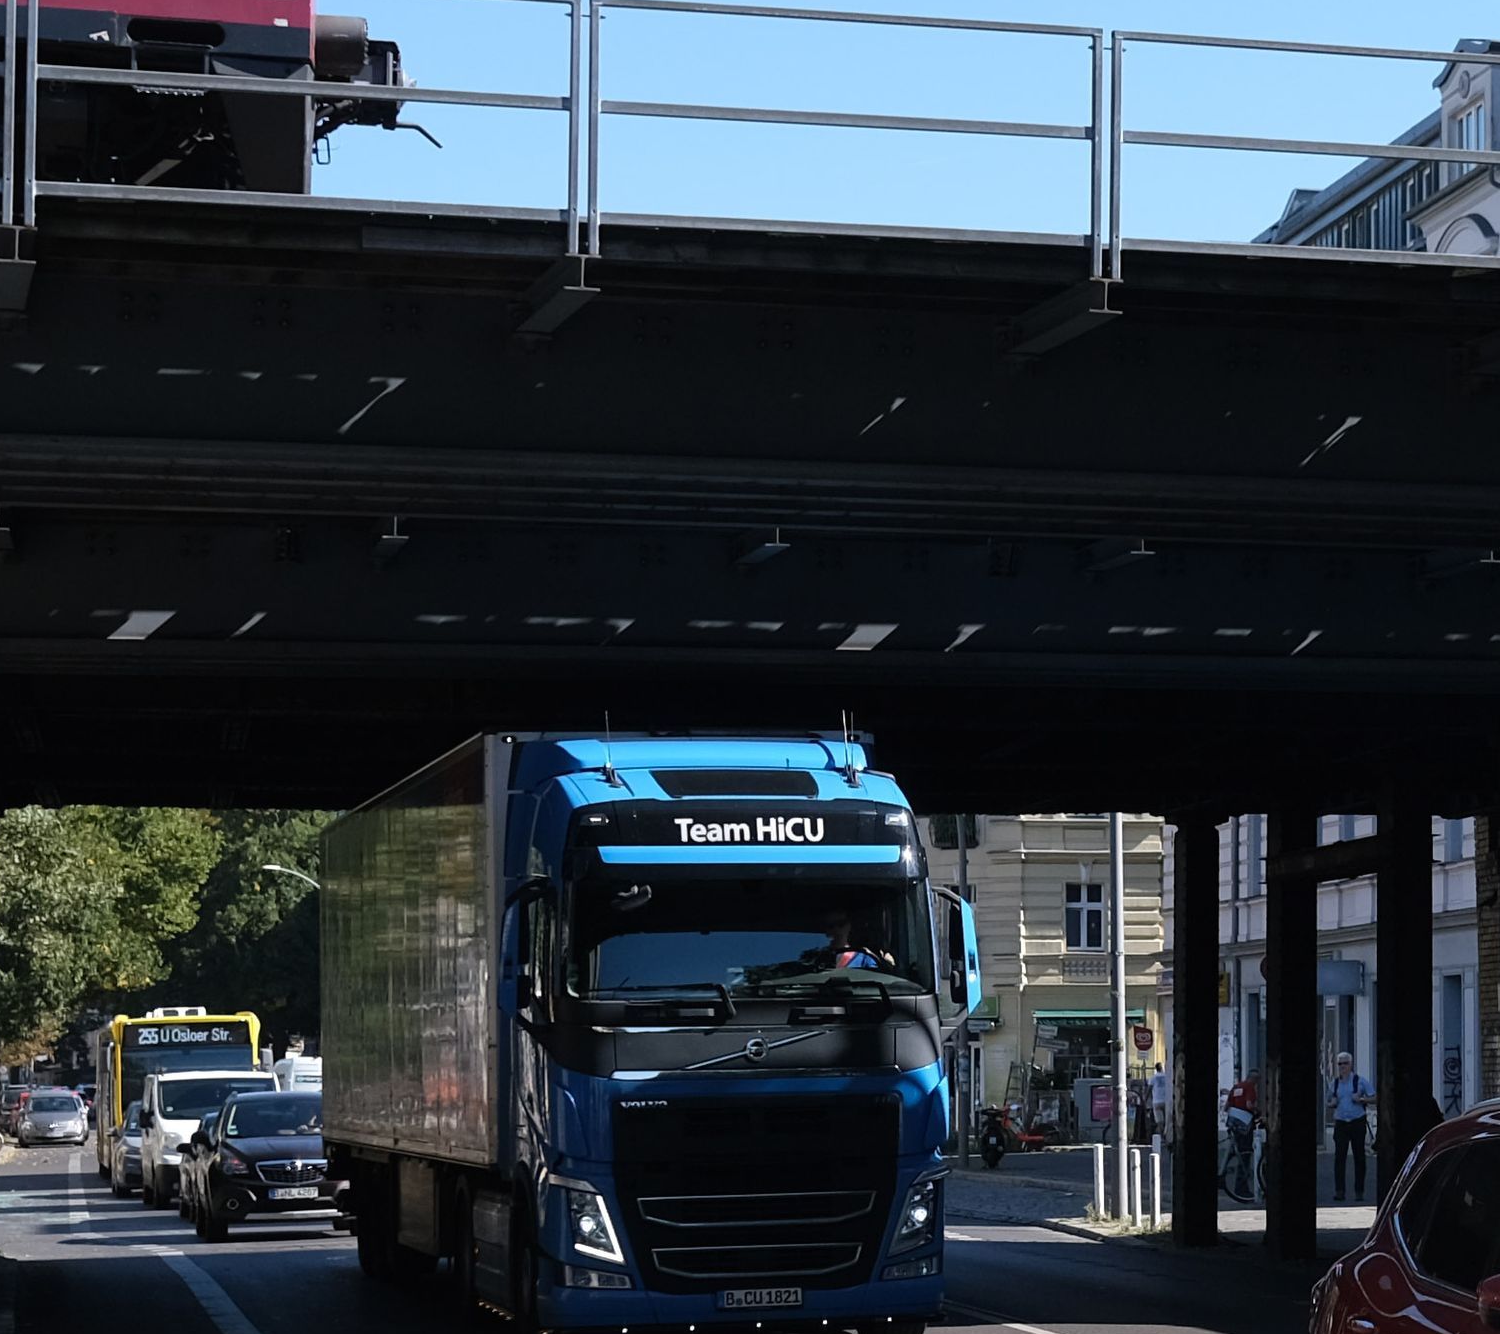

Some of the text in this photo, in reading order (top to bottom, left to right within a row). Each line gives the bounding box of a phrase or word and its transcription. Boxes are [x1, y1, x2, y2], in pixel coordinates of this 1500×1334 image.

[674, 816, 825, 843] Team HiCU
[139, 1027, 233, 1044] 255 U Osloer Str.
[726, 1289, 801, 1306] B CU 1821
